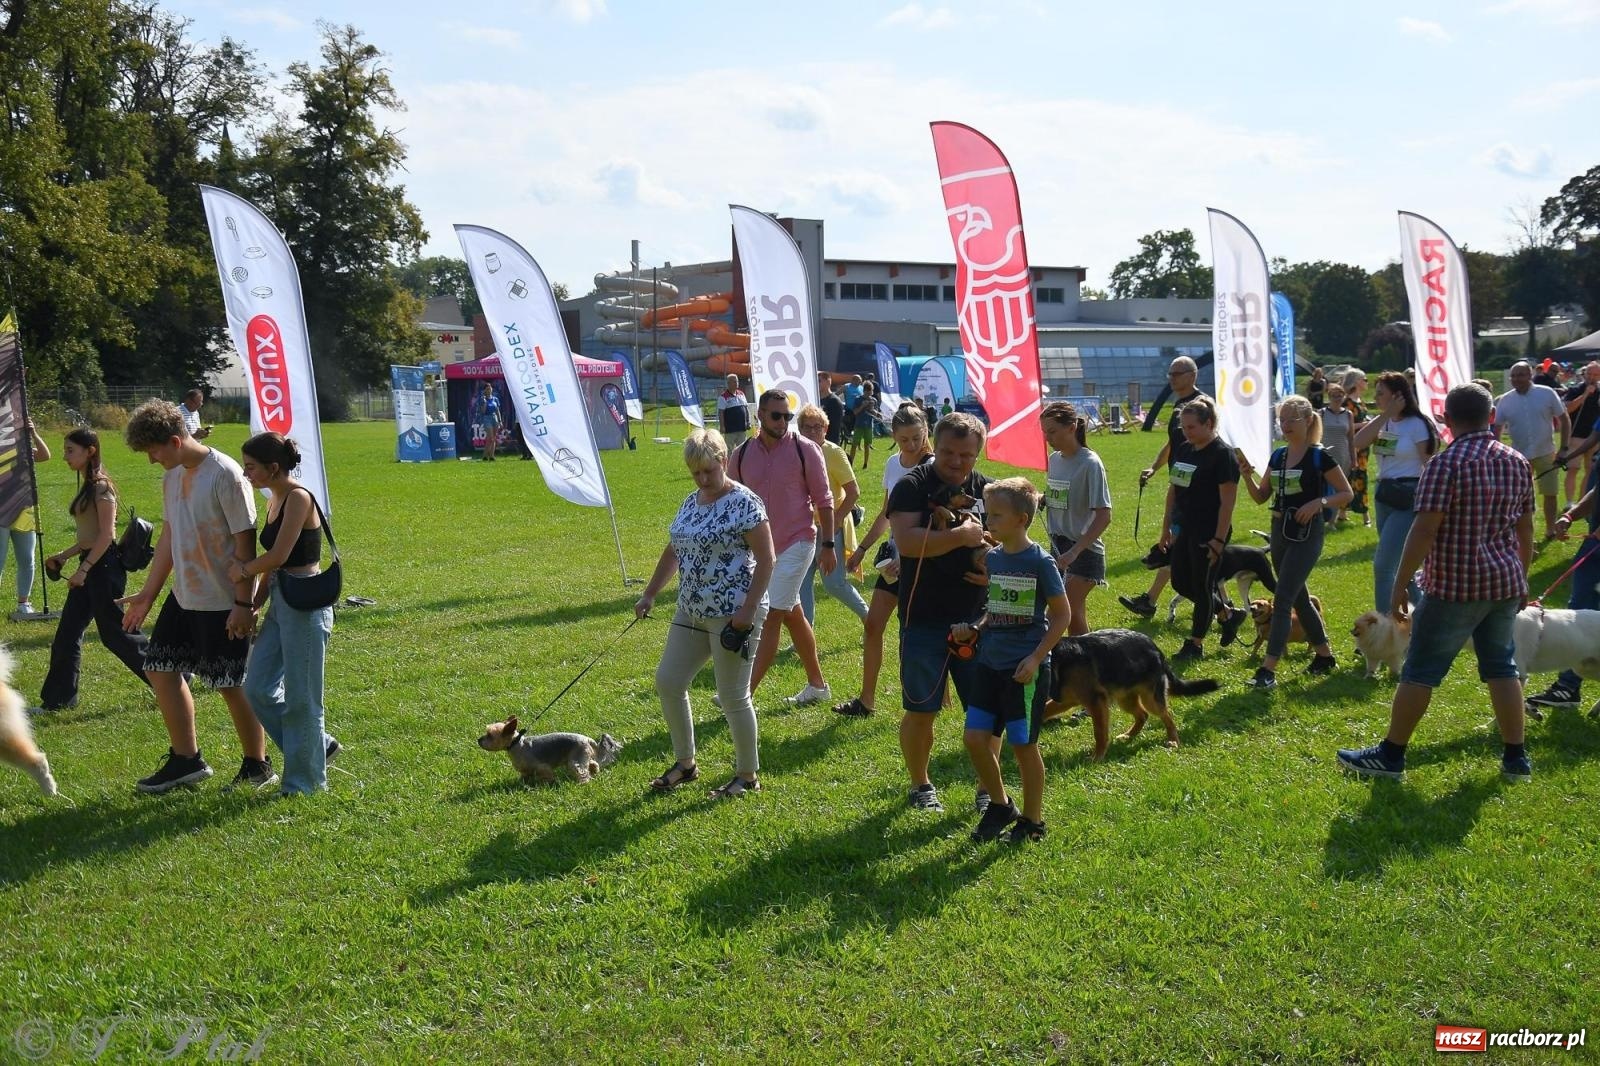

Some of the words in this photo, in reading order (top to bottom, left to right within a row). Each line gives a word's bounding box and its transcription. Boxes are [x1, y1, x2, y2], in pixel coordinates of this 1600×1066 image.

[463, 366, 483, 375] 100%
[588, 364, 616, 374] PROTEIN
[1000, 588, 1019, 603] 39
